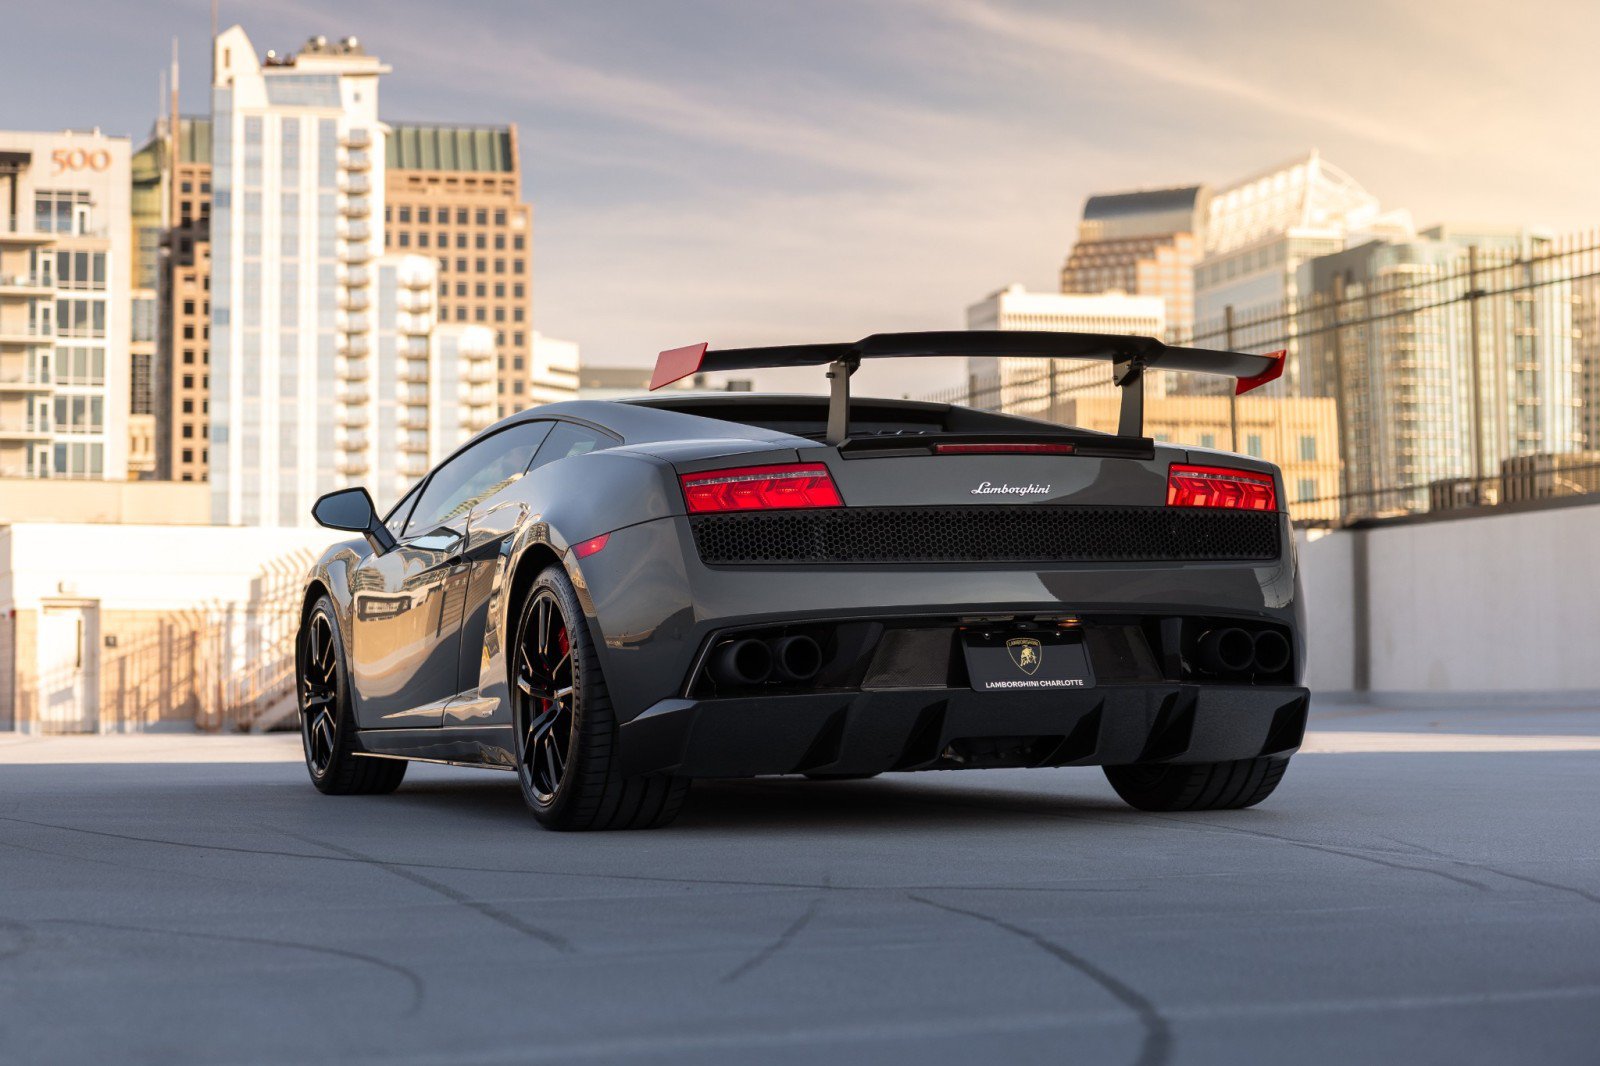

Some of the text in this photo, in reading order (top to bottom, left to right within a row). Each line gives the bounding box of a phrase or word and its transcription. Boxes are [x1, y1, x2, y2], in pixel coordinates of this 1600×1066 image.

[51, 148, 112, 175] 500
[971, 481, 1051, 496] Lamborghini
[1039, 679, 1084, 687] CHARLOTTE
